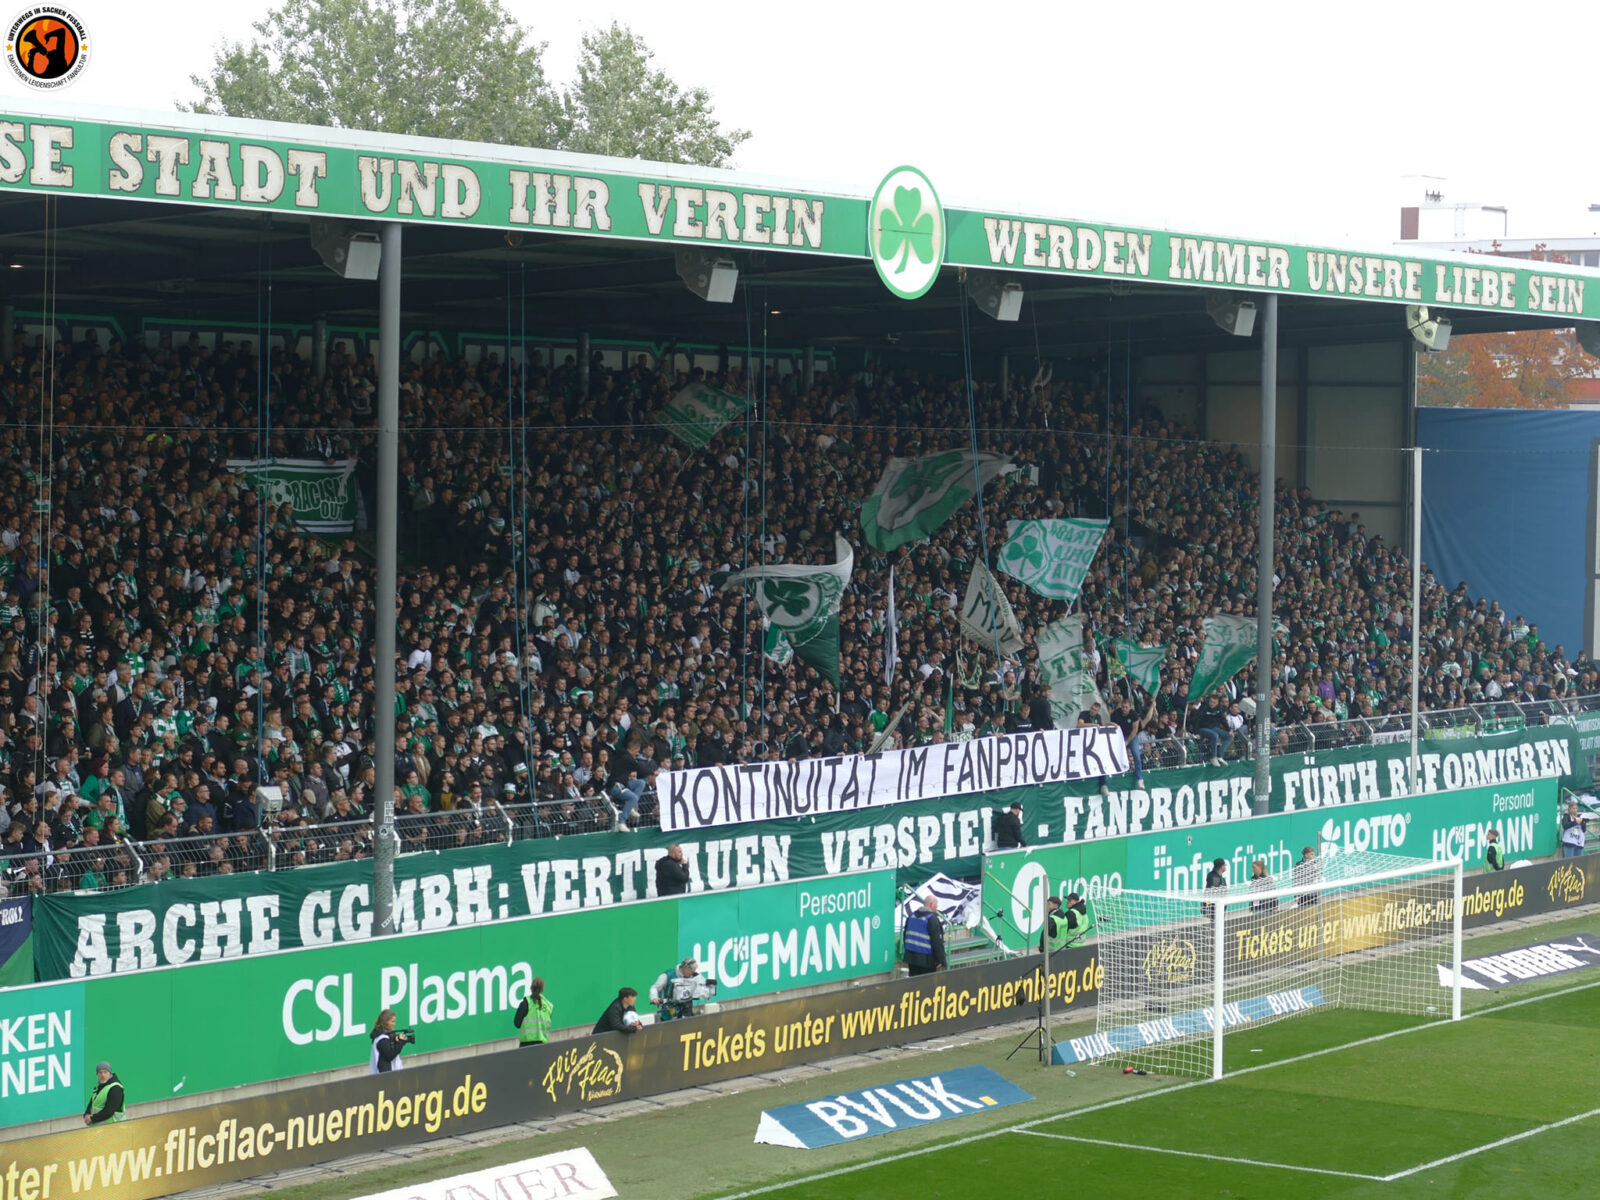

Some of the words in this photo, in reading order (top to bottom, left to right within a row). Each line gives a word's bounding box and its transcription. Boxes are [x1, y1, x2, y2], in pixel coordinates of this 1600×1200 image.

[108, 131, 327, 208] STADT
[358, 156, 481, 219] UND
[509, 169, 611, 231] IHR
[638, 182, 824, 249] VEREIN
[983, 216, 1152, 276] WERDEN
[1168, 236, 1291, 290] IMMER
[1306, 250, 1423, 300] UNSERE
[1435, 264, 1517, 308] LIEBE
[1528, 274, 1585, 315] SEIN
[670, 752, 883, 828] KONTINUITÄT
[899, 747, 929, 799] IM
[943, 726, 1122, 794] FANPROJEKT
[1493, 788, 1534, 812] Personal
[69, 894, 280, 977] ARCHE
[1283, 756, 1380, 811] FÜRTH
[1547, 864, 1565, 902] Flic
[1564, 870, 1582, 902] Flac
[799, 882, 872, 918] Personal
[1236, 924, 1293, 961] Tickets
[1298, 915, 1339, 950] uner
[1343, 878, 1524, 942] www.flicflac-nurnberg.de
[282, 973, 366, 1045] CSL
[381, 961, 533, 1027] Plasma
[1267, 989, 1313, 1015] BVUK.
[680, 1023, 766, 1072] Tickets
[774, 1014, 835, 1053] unter
[1070, 1032, 1120, 1062] BVUK.
[1137, 1017, 1185, 1045] BVUK.
[1, 1051, 71, 1097] NEN
[542, 1048, 578, 1102] Flic
[578, 1059, 616, 1100] Flac
[805, 1076, 998, 1138] BVUK.
[69, 1075, 487, 1193] www.flicflac-nuernberg.de
